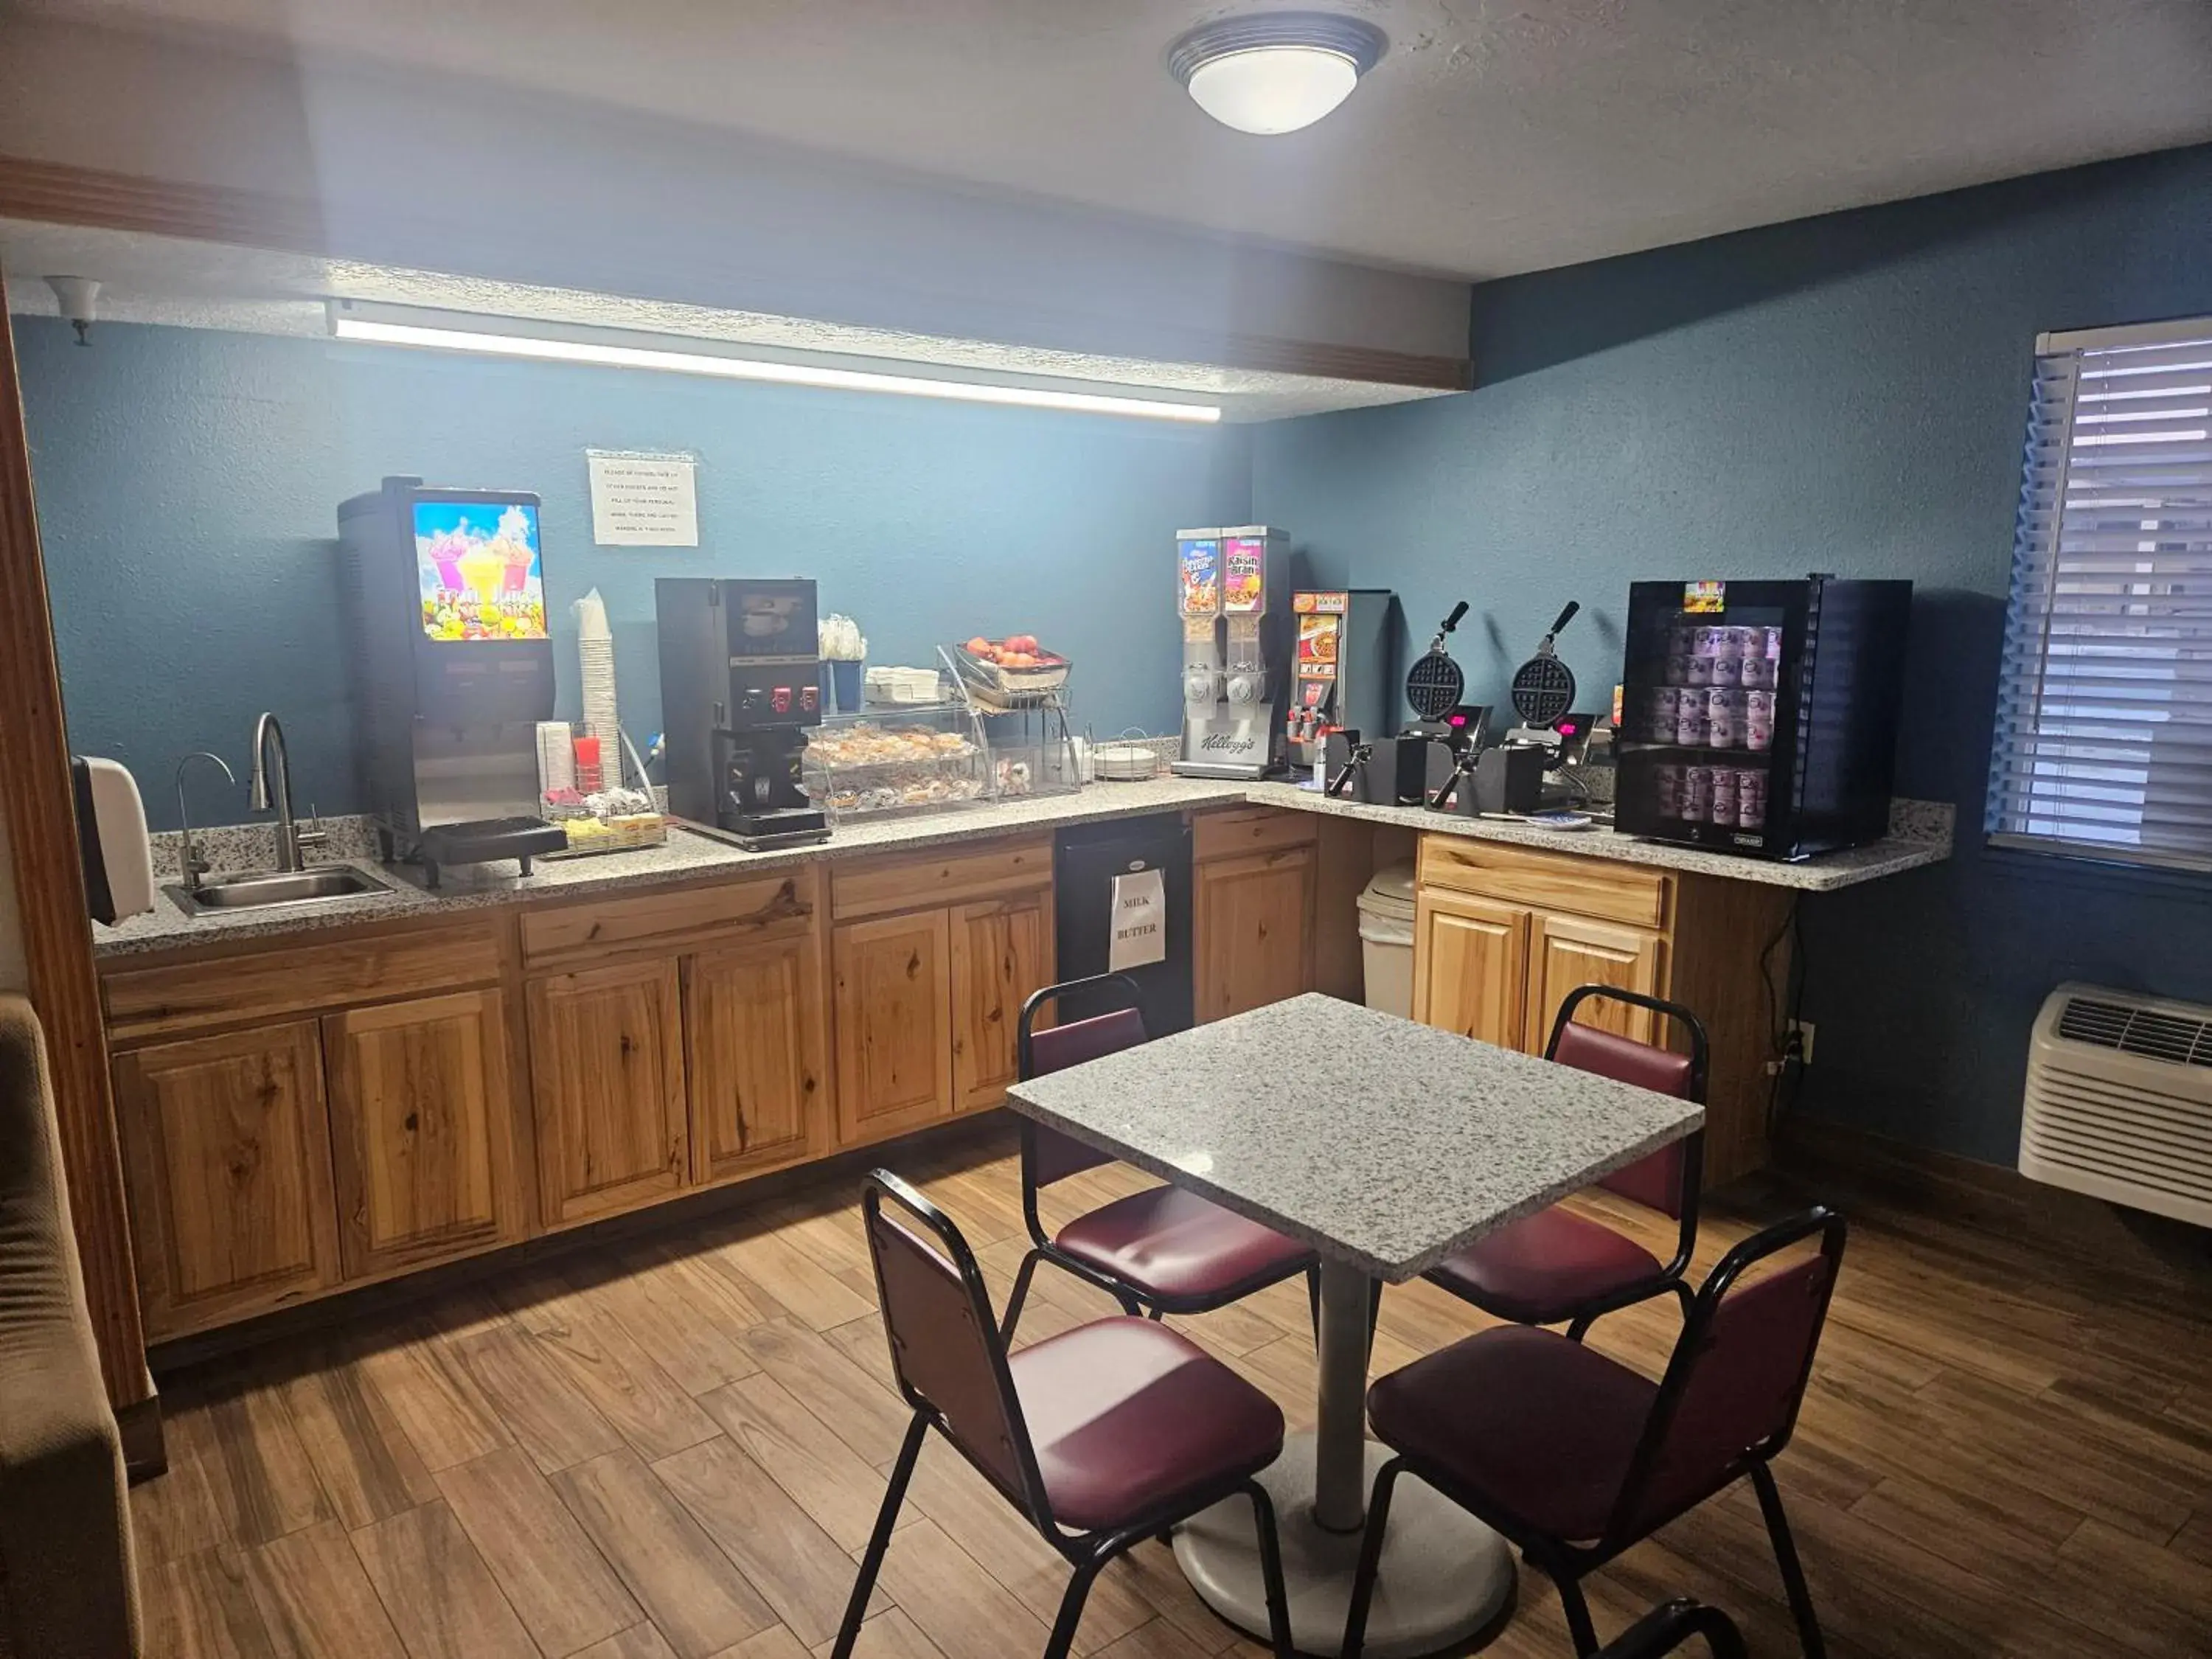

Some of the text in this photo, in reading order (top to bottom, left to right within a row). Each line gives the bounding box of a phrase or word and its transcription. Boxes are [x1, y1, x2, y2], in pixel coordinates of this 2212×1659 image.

[1201, 734, 1255, 754] Kellogg's
[1124, 896, 1150, 909] MILK
[1117, 923, 1157, 940] BUTTER
